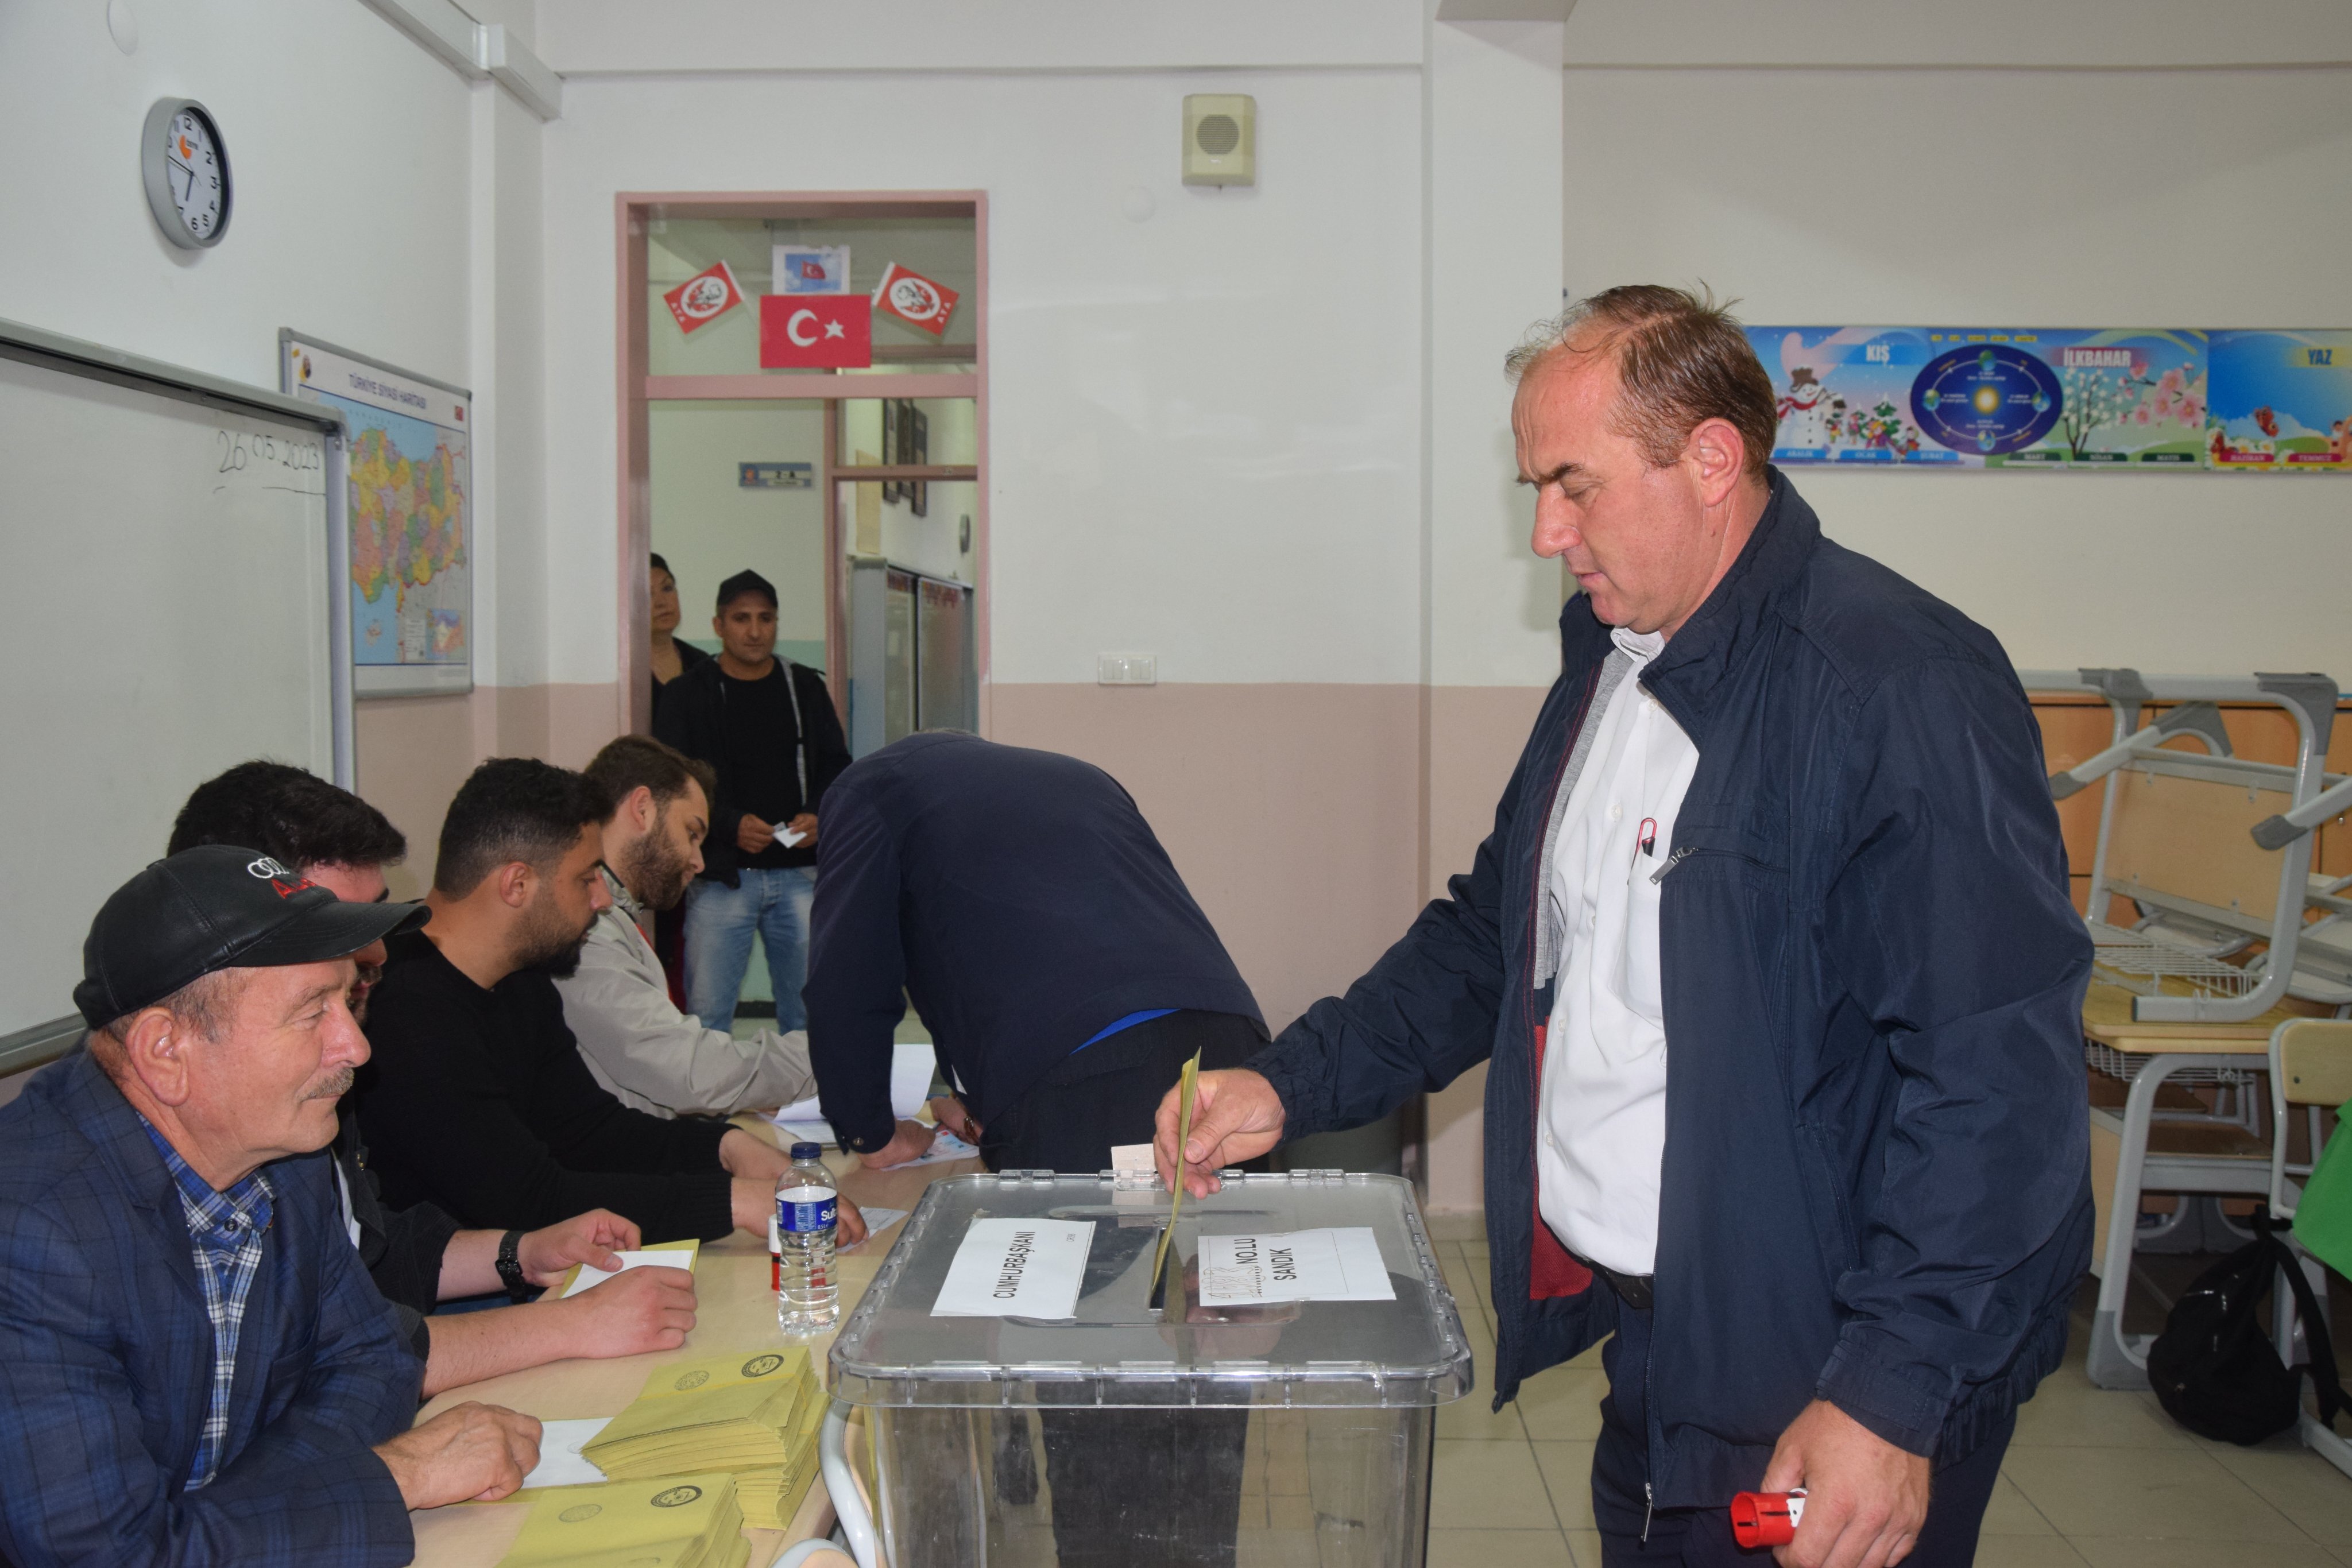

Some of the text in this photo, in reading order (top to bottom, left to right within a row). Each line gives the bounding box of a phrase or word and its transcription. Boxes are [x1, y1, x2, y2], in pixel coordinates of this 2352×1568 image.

[184, 117, 192, 130] 12
[206, 150, 212, 165] 2
[210, 176, 217, 189] 3
[210, 200, 216, 214] 4
[191, 217, 198, 230] 6
[202, 214, 209, 227] 5
[1867, 345, 1890, 364] KIŞ
[2064, 347, 2132, 366] İLKBAHAR
[2308, 349, 2332, 365] YAZ
[348, 373, 377, 394] TÜRKİYE
[1234, 1238, 1259, 1264] NO.LU
[993, 1232, 1035, 1298] CUMHURBAŞKANI
[1269, 1248, 1297, 1281] SANDIK
